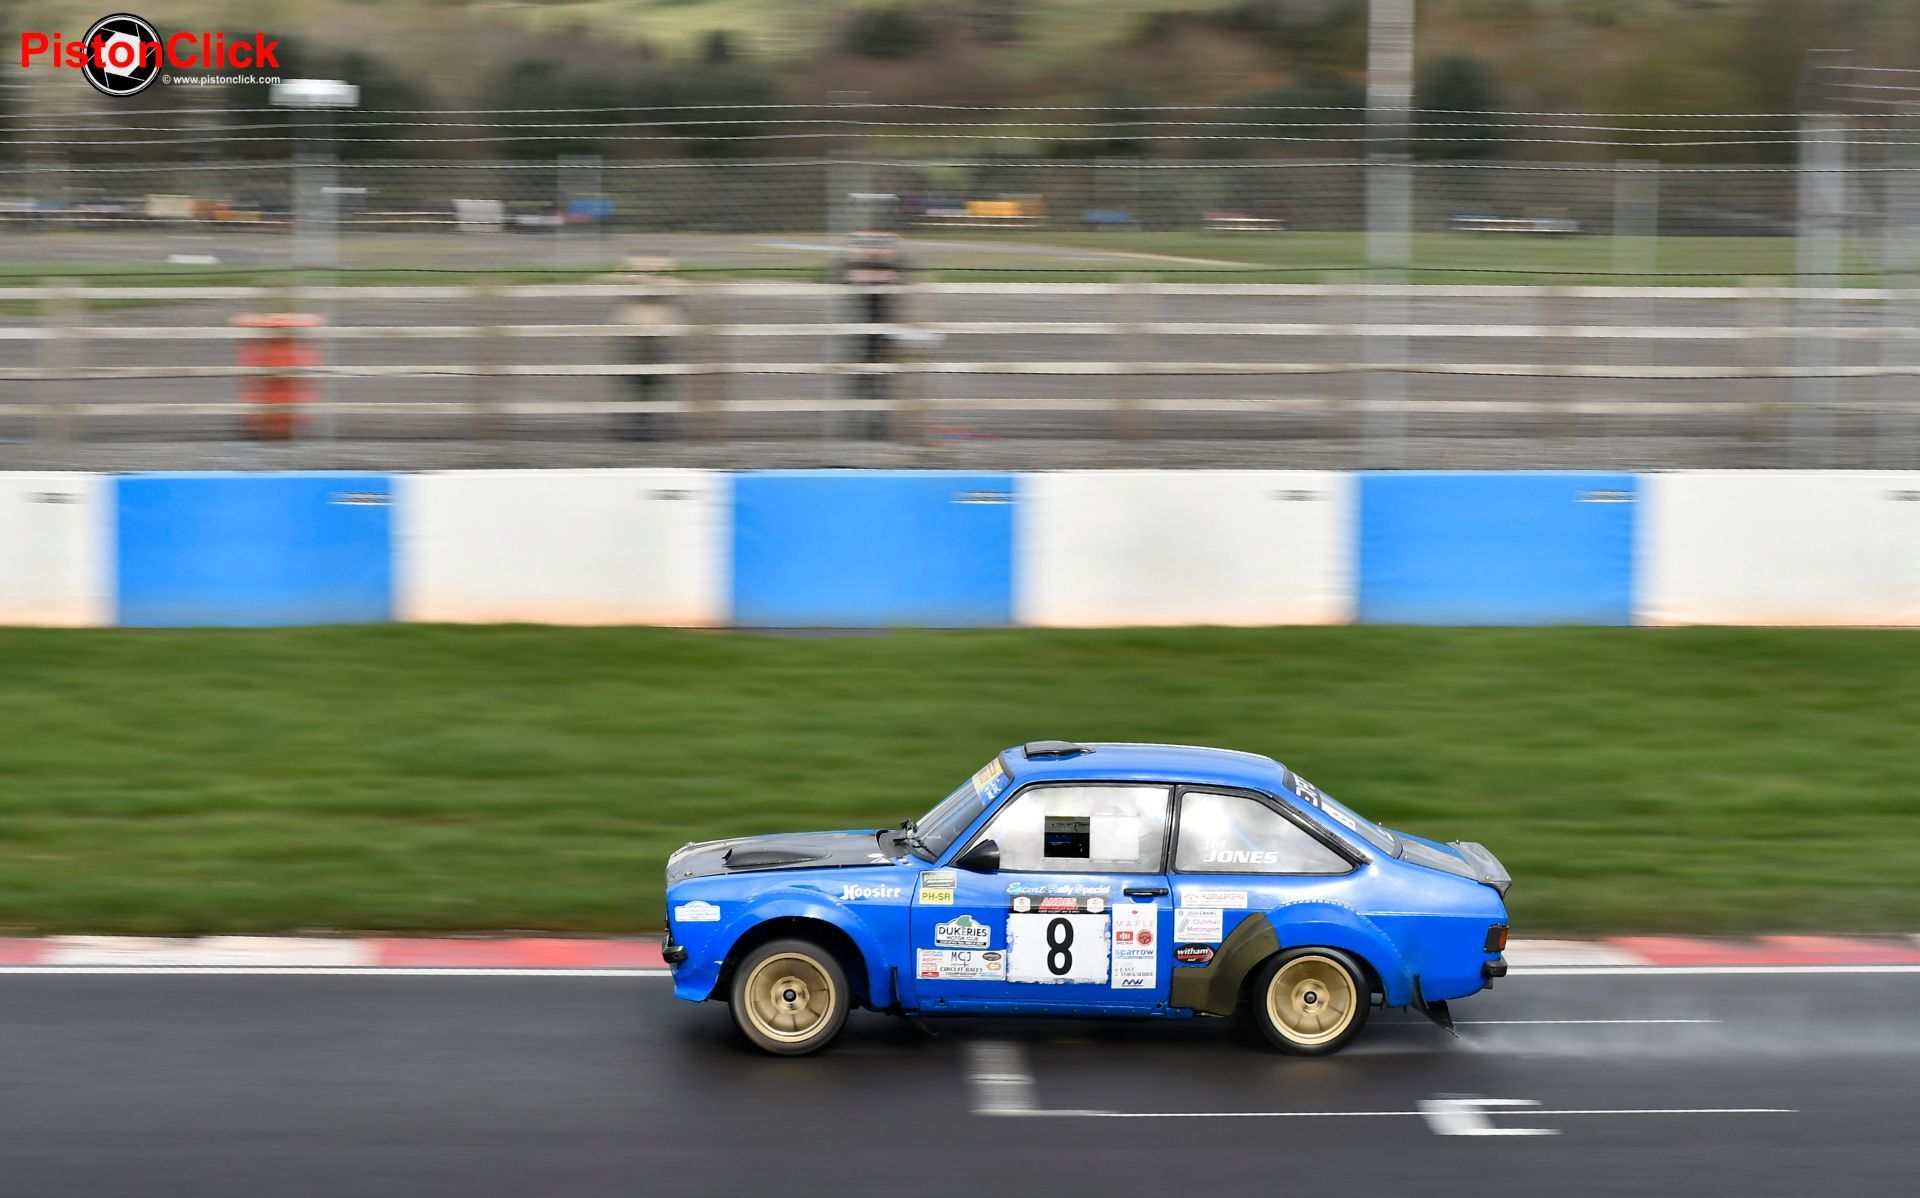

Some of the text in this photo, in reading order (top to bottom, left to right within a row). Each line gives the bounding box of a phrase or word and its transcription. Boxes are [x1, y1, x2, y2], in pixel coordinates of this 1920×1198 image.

[1203, 850, 1279, 864] JONES
[840, 884, 901, 900] Hoosier
[922, 892, 951, 901] PH-SR
[938, 926, 988, 937] DUKERIES
[1046, 917, 1074, 976] 8
[1177, 947, 1209, 955] witham
[1115, 949, 1154, 958] sparrow
